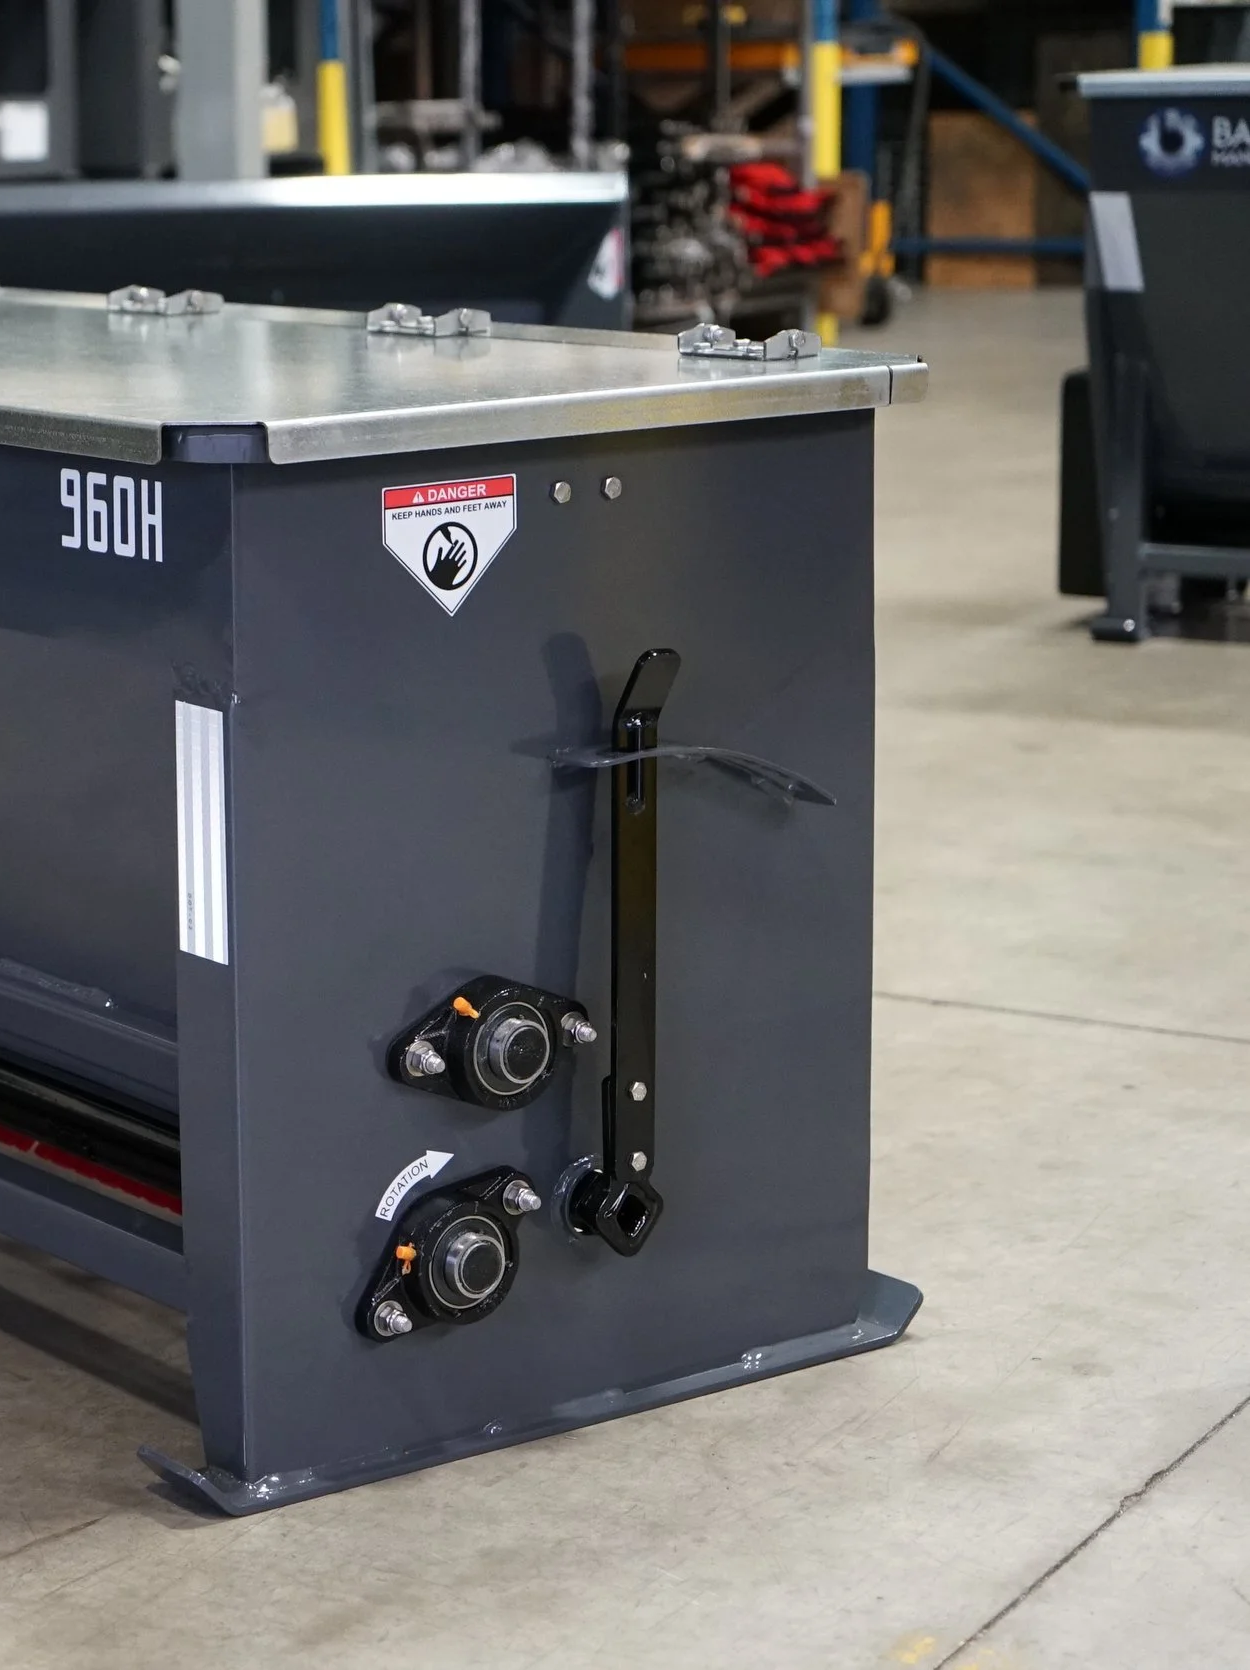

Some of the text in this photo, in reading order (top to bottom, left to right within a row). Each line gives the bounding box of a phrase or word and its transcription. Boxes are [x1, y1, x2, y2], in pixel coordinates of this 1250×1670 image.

[392, 500, 507, 520] KEEP HANDS AND FEET AWAY
[428, 484, 486, 501] DANGER
[60, 467, 163, 562] 960H
[380, 1160, 429, 1217] ROTATION
